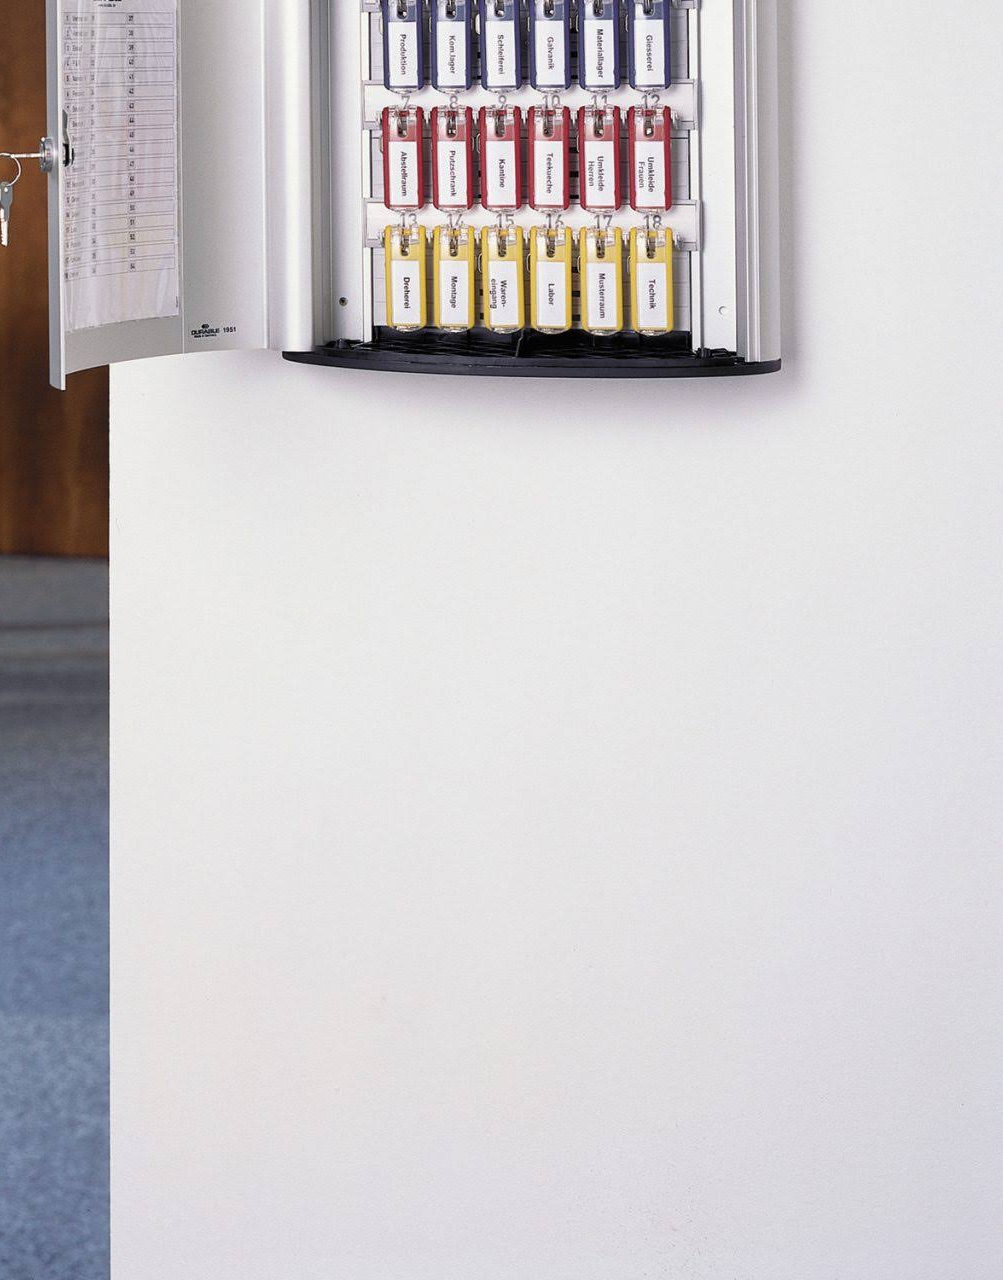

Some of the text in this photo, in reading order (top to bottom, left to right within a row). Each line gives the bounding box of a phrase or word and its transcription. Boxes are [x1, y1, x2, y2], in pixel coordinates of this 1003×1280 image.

[399, 33, 407, 75] Produktion
[497, 34, 505, 75] Schleiferei
[547, 36, 555, 70] Galvanik
[596, 28, 604, 78] Materiallager
[645, 34, 654, 72] Giesserei
[401, 95, 410, 109] 7
[449, 95, 458, 109] 8
[498, 95, 507, 109] 9
[542, 95, 560, 108] 10
[591, 95, 608, 108] 11
[641, 94, 660, 108] 12
[449, 150, 457, 196] Putzschrank
[596, 156, 604, 192] Umkleide
[647, 156, 655, 193] Umkleide
[400, 213, 417, 227] 13
[496, 213, 514, 227] 15
[594, 214, 613, 228] 17
[643, 214, 662, 229] 18
[449, 276, 457, 308] Montage
[490, 278, 498, 309] eingang
[598, 273, 606, 319] Musterraum
